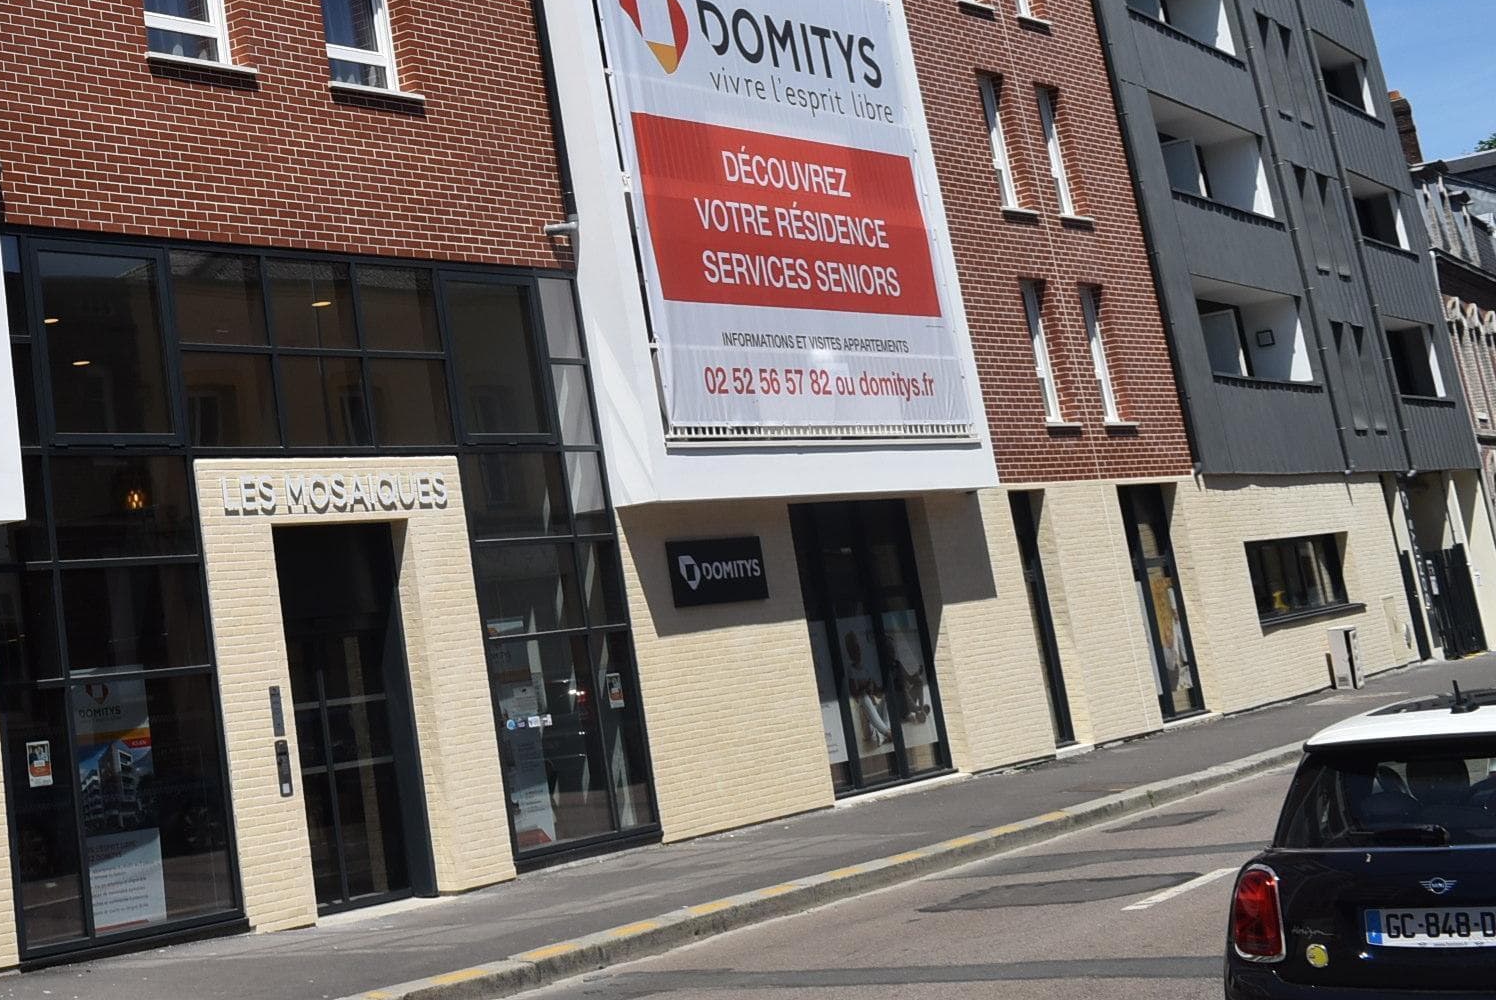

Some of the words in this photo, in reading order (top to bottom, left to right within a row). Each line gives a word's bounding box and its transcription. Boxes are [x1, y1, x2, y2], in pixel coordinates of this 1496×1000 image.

[709, 66, 766, 101] vivre
[771, 74, 846, 118] l'esprit
[851, 89, 894, 124] libre
[721, 145, 851, 198] DÉCOUVREZ
[693, 197, 773, 236] VOTRE
[774, 201, 889, 249] RÉSIDENCE
[702, 250, 812, 291] SERVICES
[814, 260, 901, 297] SENIORS
[721, 331, 795, 349] INFORMATIONS
[796, 336, 807, 349] ET
[808, 336, 843, 351] VISITES
[843, 337, 909, 354] APPARTEMENTS
[704, 366, 729, 395] 02
[732, 367, 756, 395] 52
[759, 368, 781, 395] 56
[785, 369, 804, 395] 57
[808, 369, 832, 395] 82
[836, 375, 856, 396] ou
[859, 371, 934, 402] domitys.fr
[220, 474, 276, 513] LES
[701, 558, 761, 580] DOMITYS
